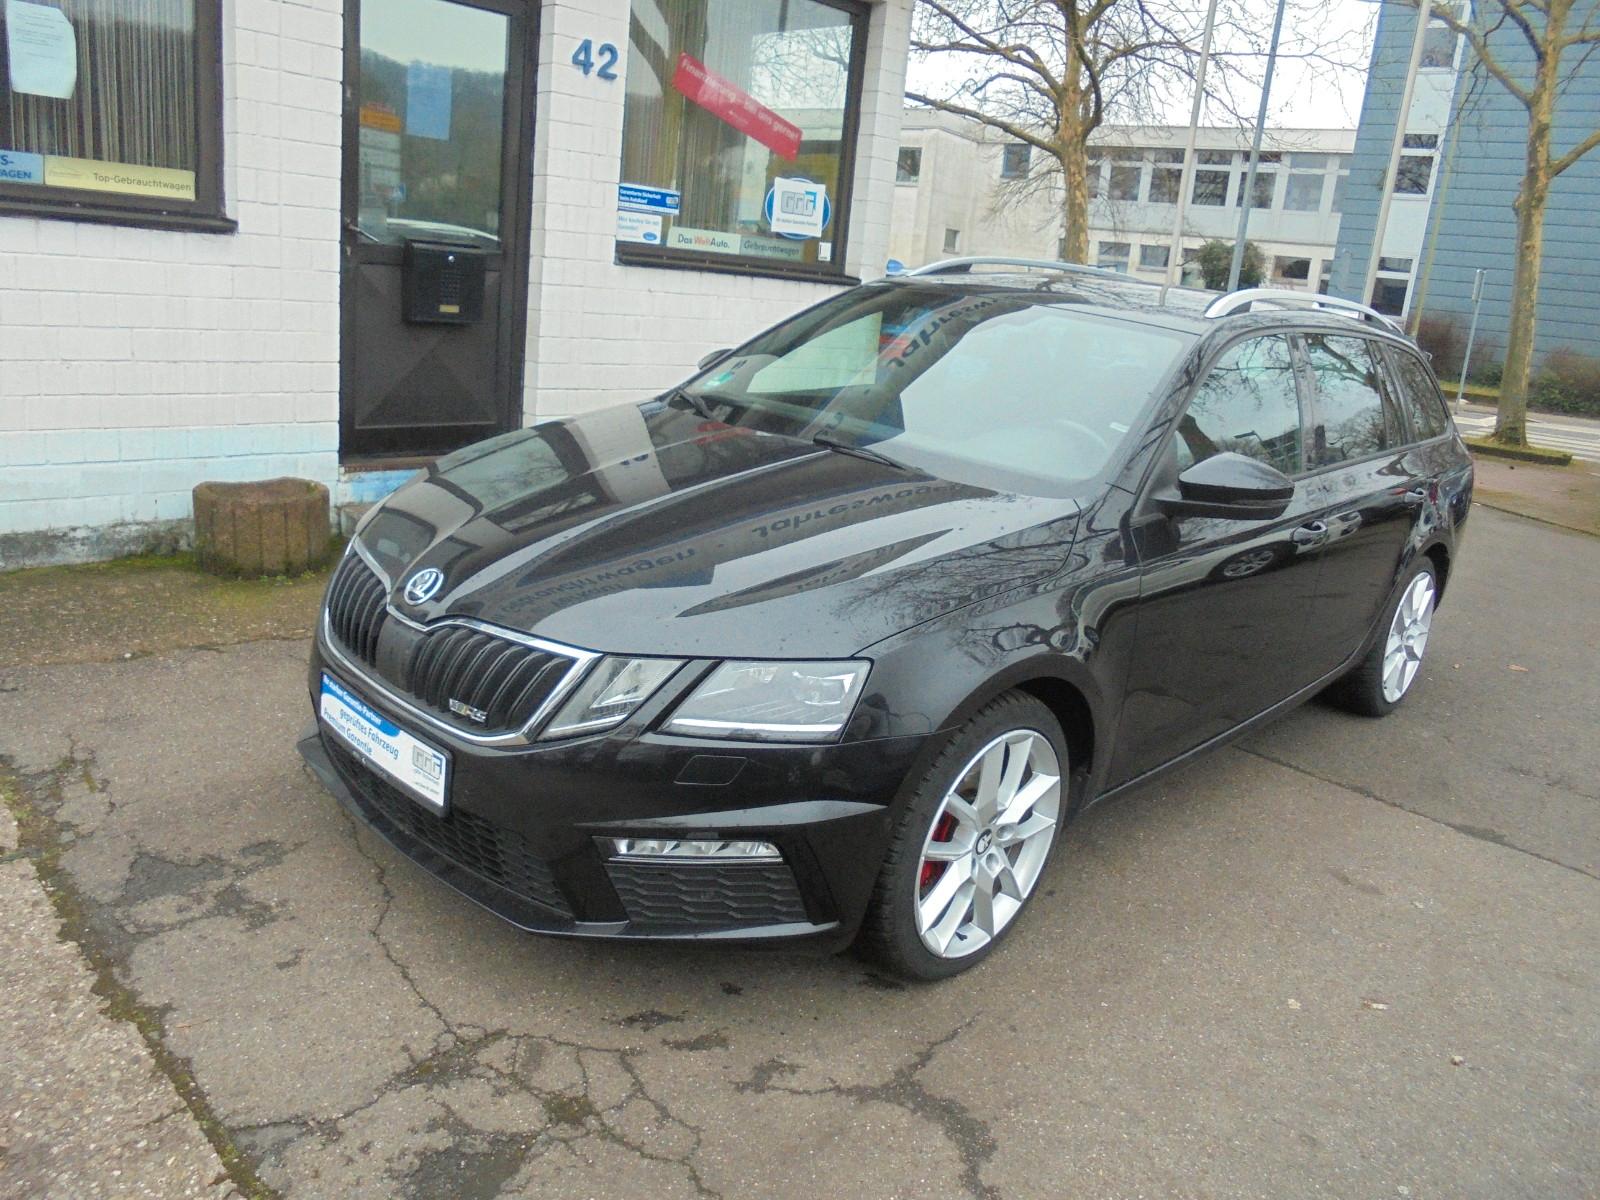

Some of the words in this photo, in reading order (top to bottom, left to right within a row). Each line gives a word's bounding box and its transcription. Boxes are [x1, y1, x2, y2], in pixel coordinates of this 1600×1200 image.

[572, 39, 619, 81] 42
[0, 168, 32, 180] AGEN
[93, 172, 192, 192] Top-Gebrauchtwagen
[678, 233, 693, 244] Das
[346, 728, 373, 756] Garantie
[367, 727, 400, 760] Fahrzeug
